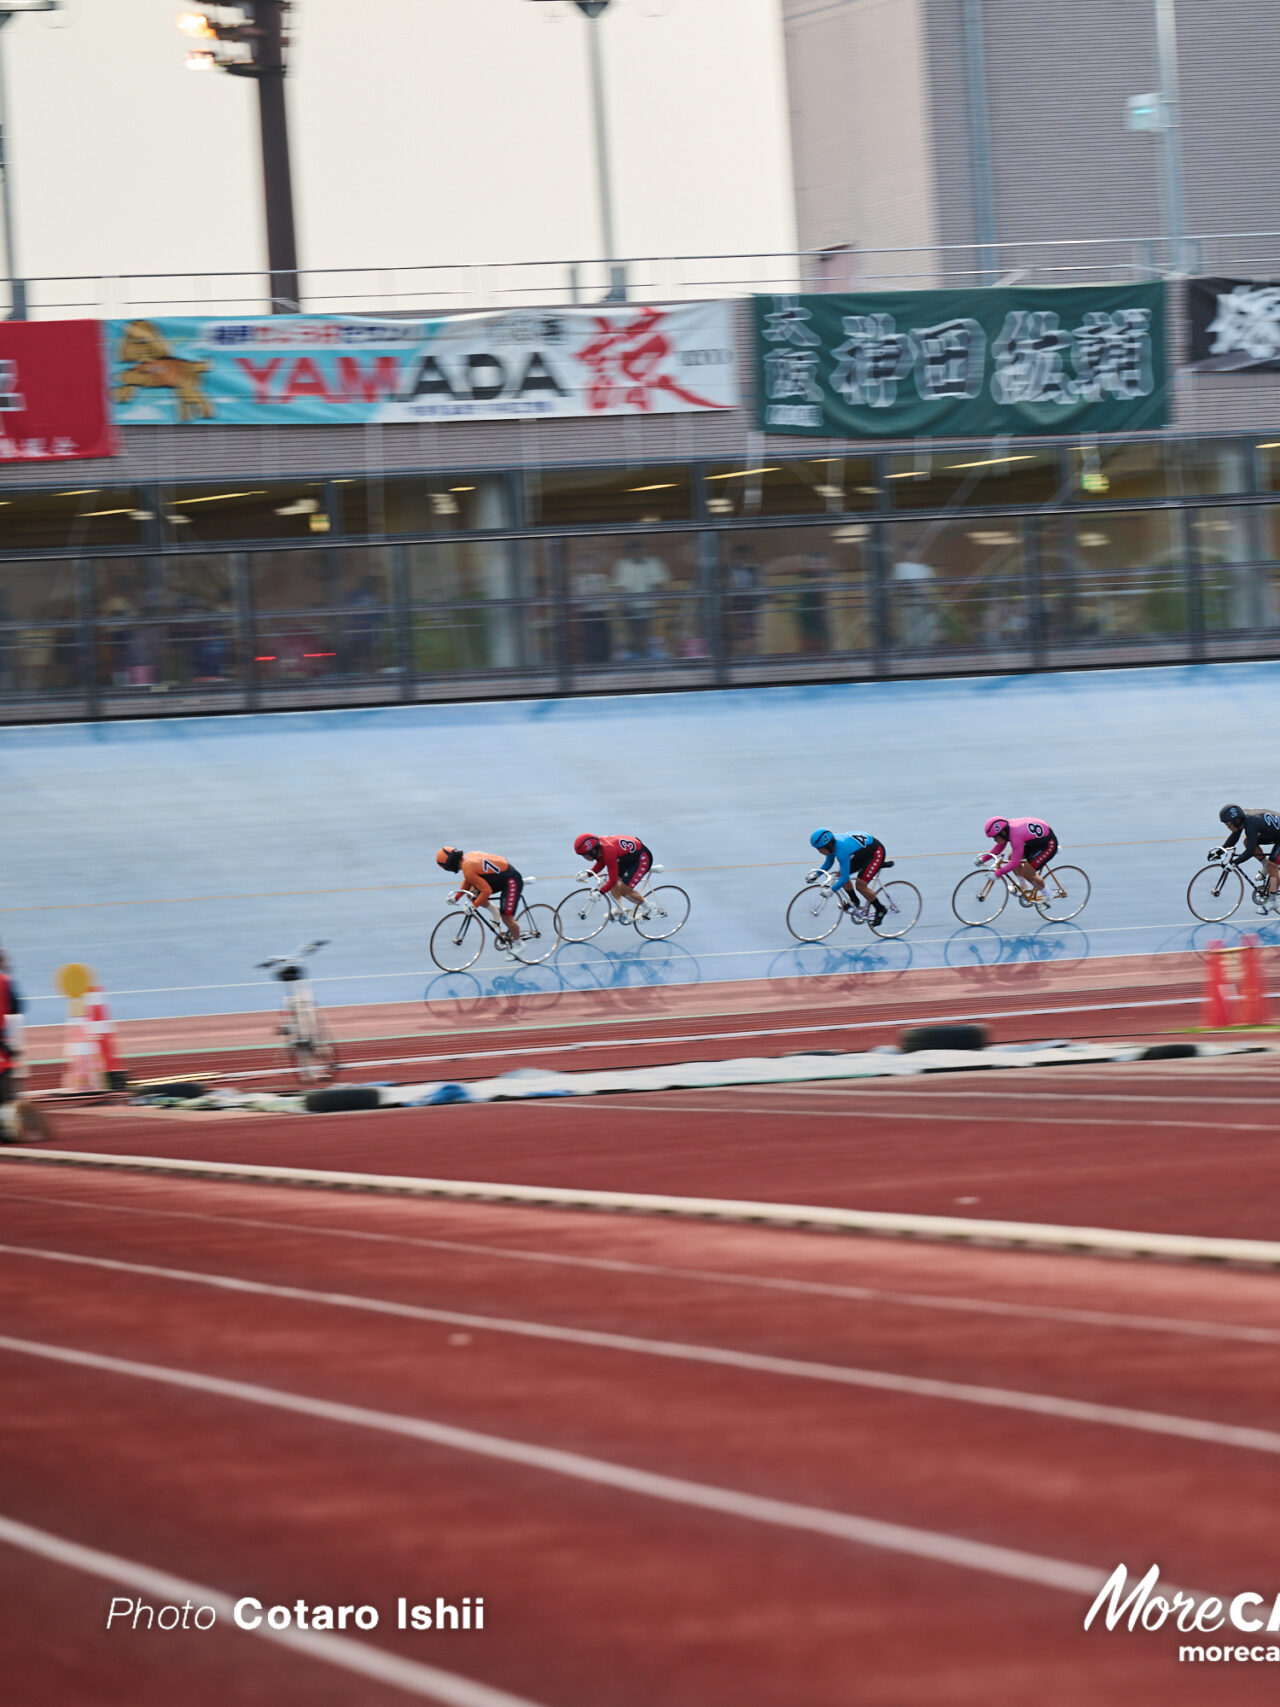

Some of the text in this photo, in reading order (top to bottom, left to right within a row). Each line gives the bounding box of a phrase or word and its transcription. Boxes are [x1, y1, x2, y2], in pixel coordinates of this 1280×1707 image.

[234, 351, 569, 404] YAMADA
[1264, 812, 1280, 831] 2
[1027, 822, 1044, 838] 8
[619, 839, 637, 854] 3
[851, 833, 868, 848] 4
[483, 858, 500, 874] 7
